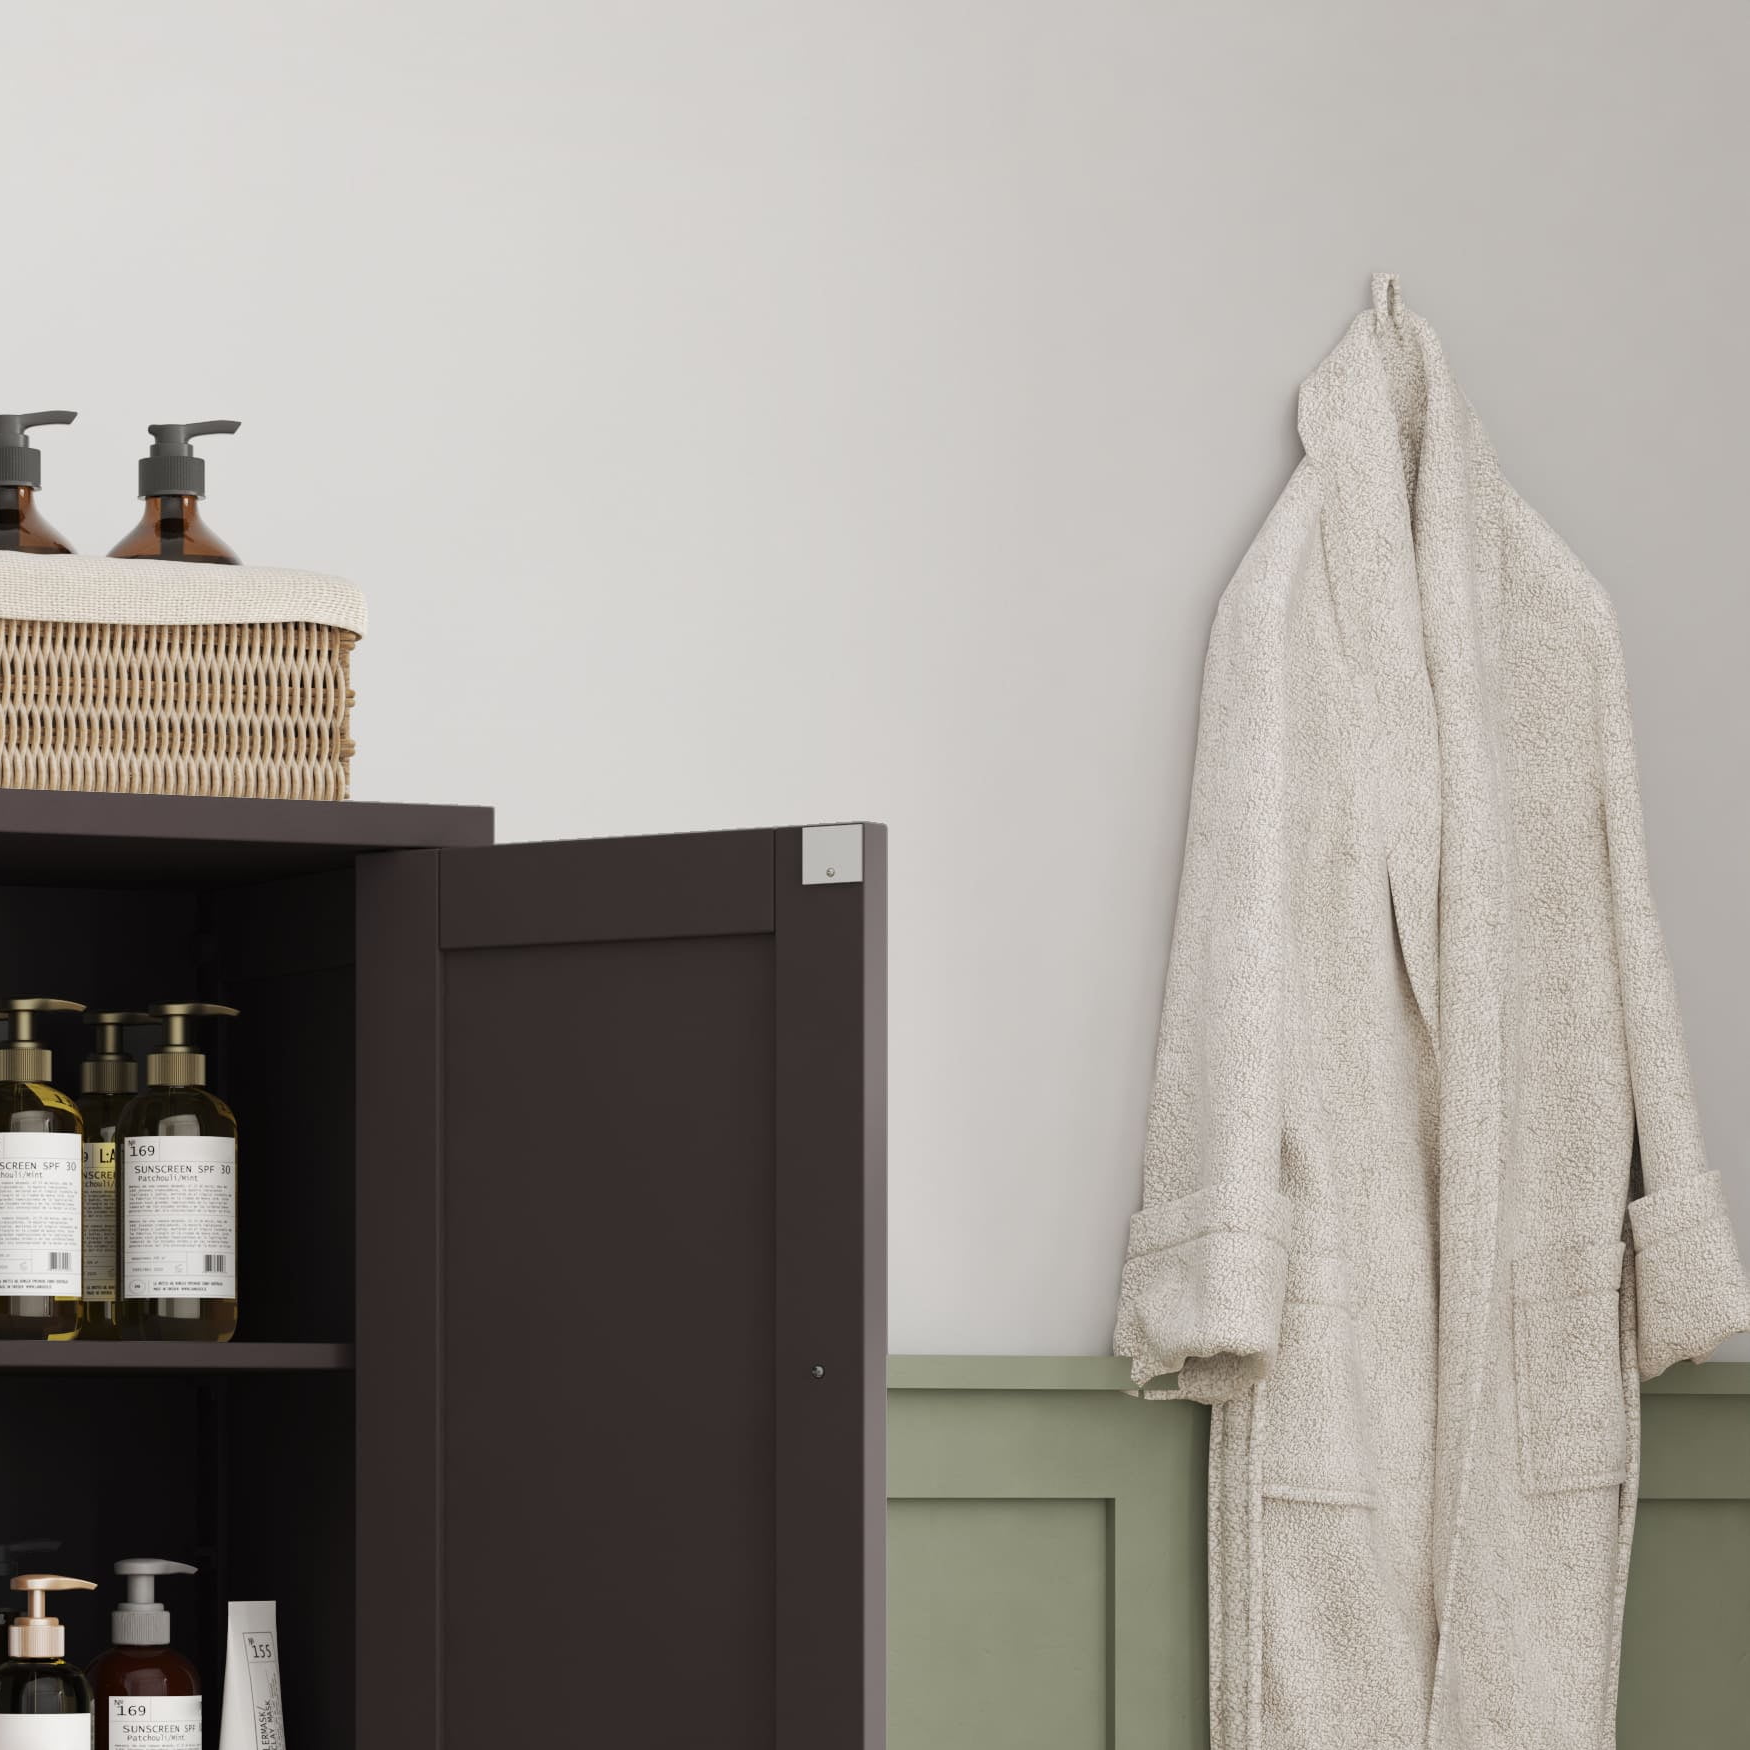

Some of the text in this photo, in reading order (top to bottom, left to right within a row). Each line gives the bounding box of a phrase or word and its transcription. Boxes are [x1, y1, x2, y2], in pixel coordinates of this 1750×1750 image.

[129, 1145, 155, 1157] 169
[43, 1161, 61, 1170] SPF
[66, 1161, 77, 1171] 30
[134, 1165, 231, 1174] SUNSCREEN SPF 30
[138, 1174, 198, 1182] Patchouli/Mint
[252, 1644, 272, 1658] 155
[117, 1705, 146, 1716] 169
[123, 1725, 180, 1733] SUNSCREEN
[184, 1725, 195, 1733] SPF
[265, 1699, 278, 1750] CLAY MASK
